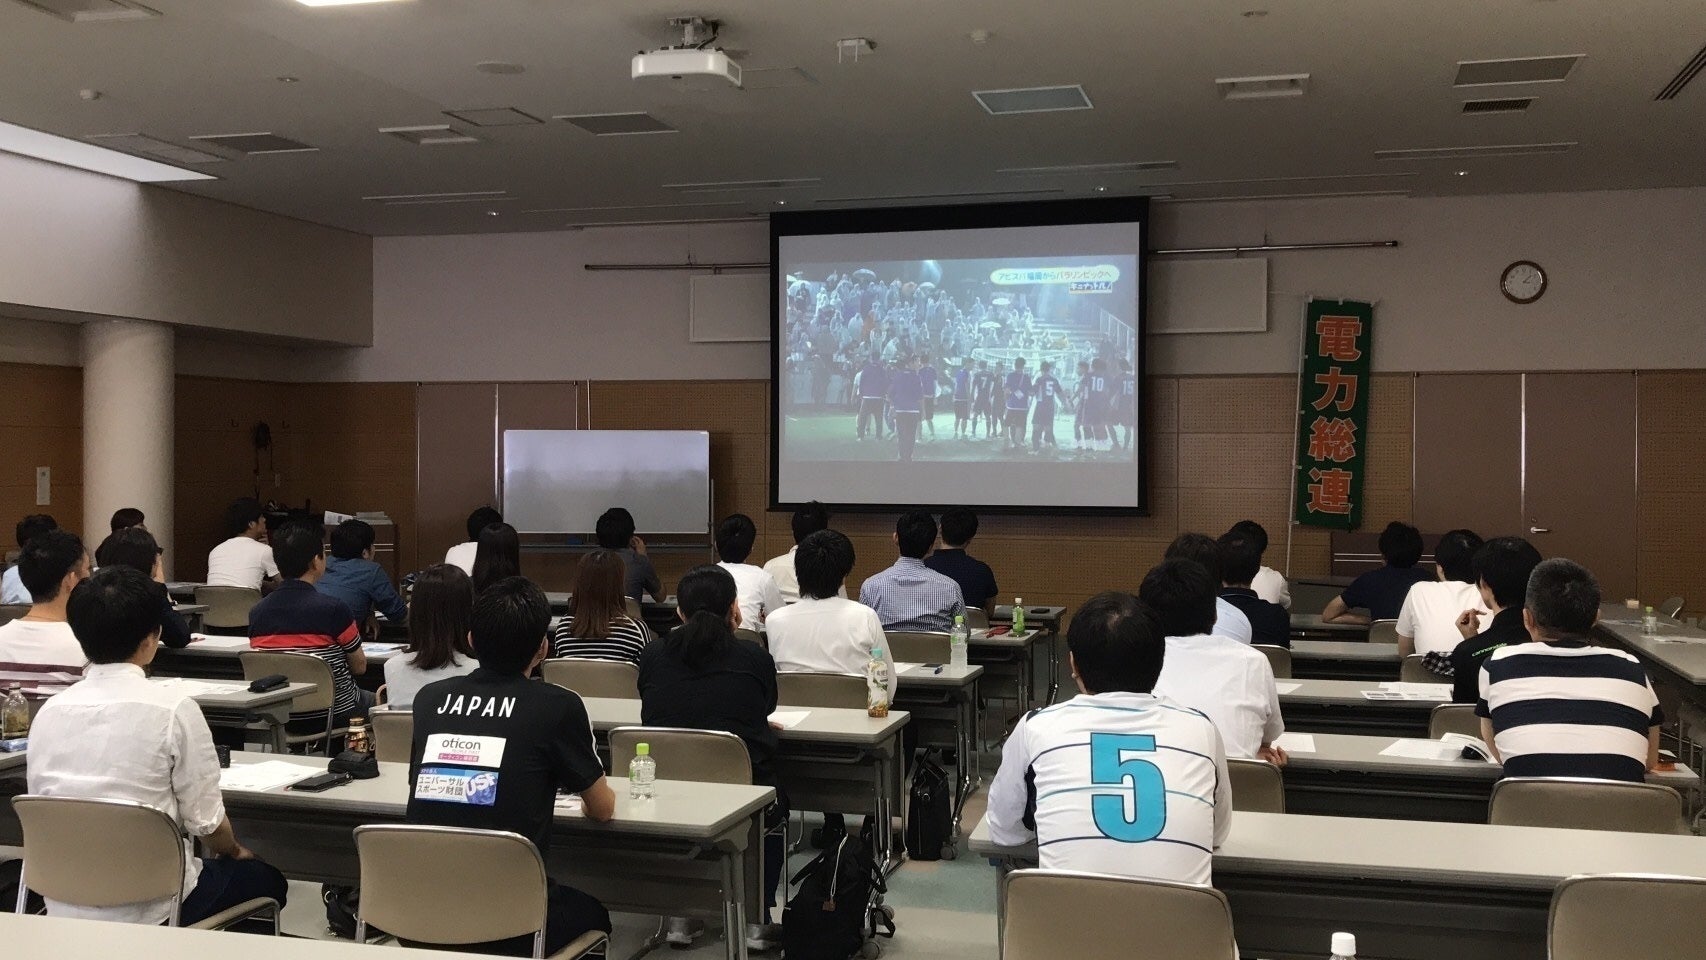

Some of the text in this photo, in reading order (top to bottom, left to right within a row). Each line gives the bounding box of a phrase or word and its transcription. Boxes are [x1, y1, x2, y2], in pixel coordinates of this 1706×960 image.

[1045, 381, 1054, 396] 5
[1091, 376, 1104, 392] 10
[1306, 315, 1362, 514] 電力総連
[437, 693, 516, 718] JAPAN
[441, 738, 482, 750] oticon
[418, 776, 465, 786] ユニバーサル
[1090, 732, 1167, 843] 5
[417, 784, 464, 796] スポーツ財団
